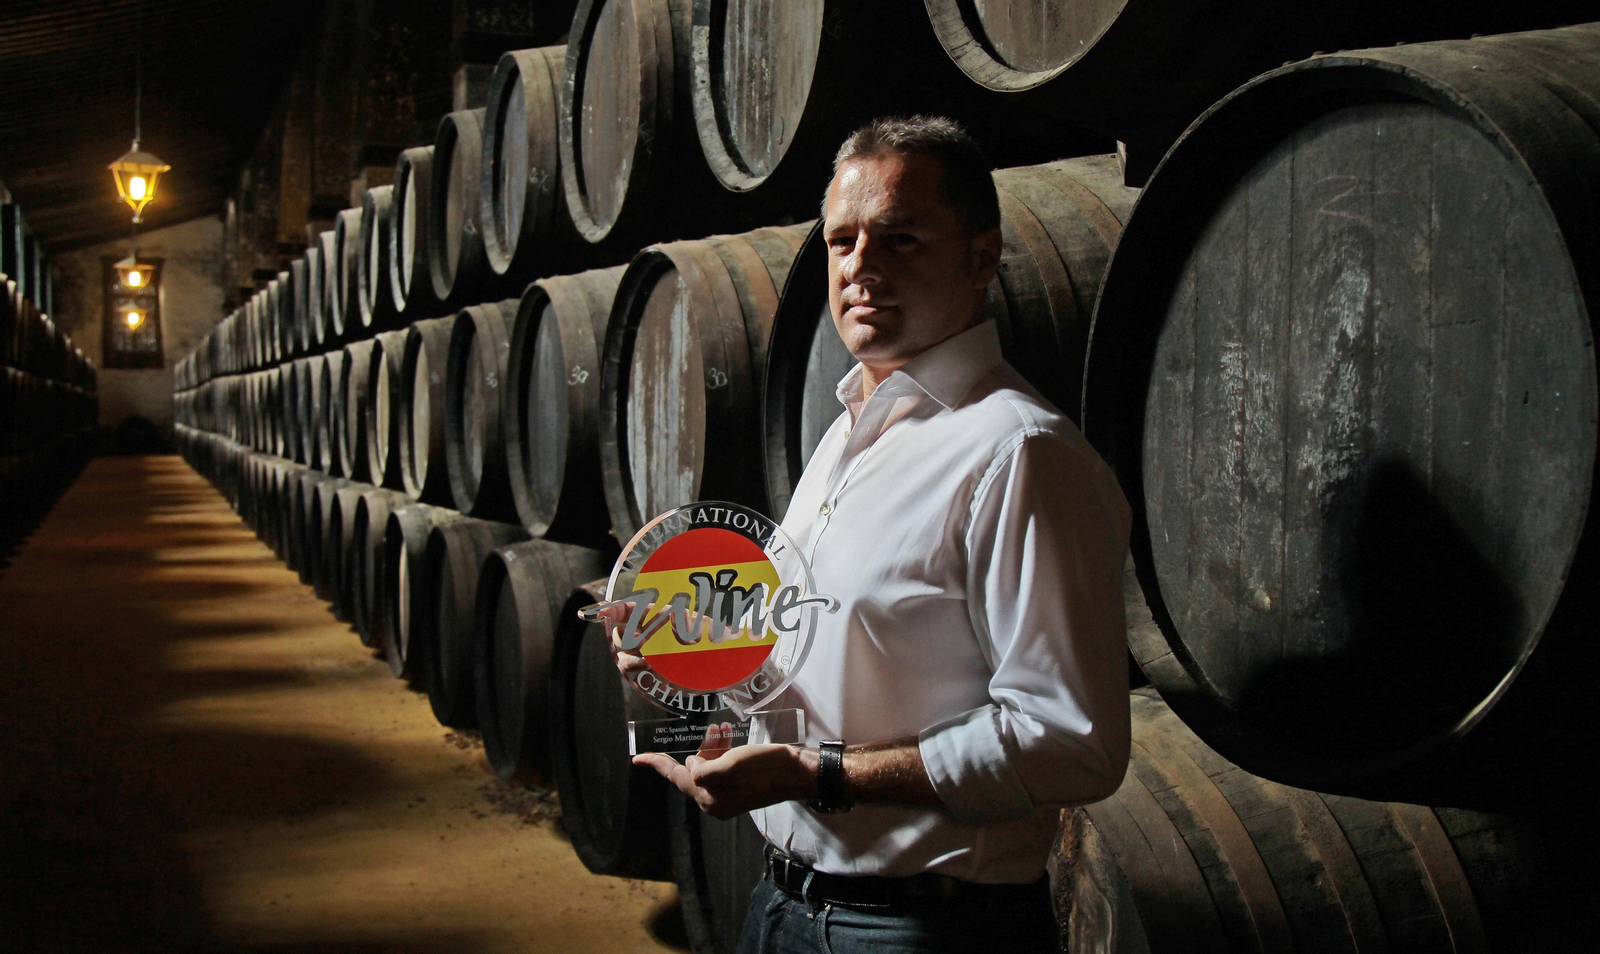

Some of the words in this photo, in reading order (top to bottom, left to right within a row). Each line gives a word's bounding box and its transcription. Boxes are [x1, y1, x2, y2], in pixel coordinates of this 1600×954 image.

[706, 367, 729, 390] 30
[620, 506, 788, 574] INTERNATIONAL
[636, 664, 784, 712] CHALLENGE
[653, 735, 673, 744] Sergio
[674, 732, 703, 742] Martínez
[722, 730, 745, 739] Emilio
[669, 725, 689, 734] Spanish
